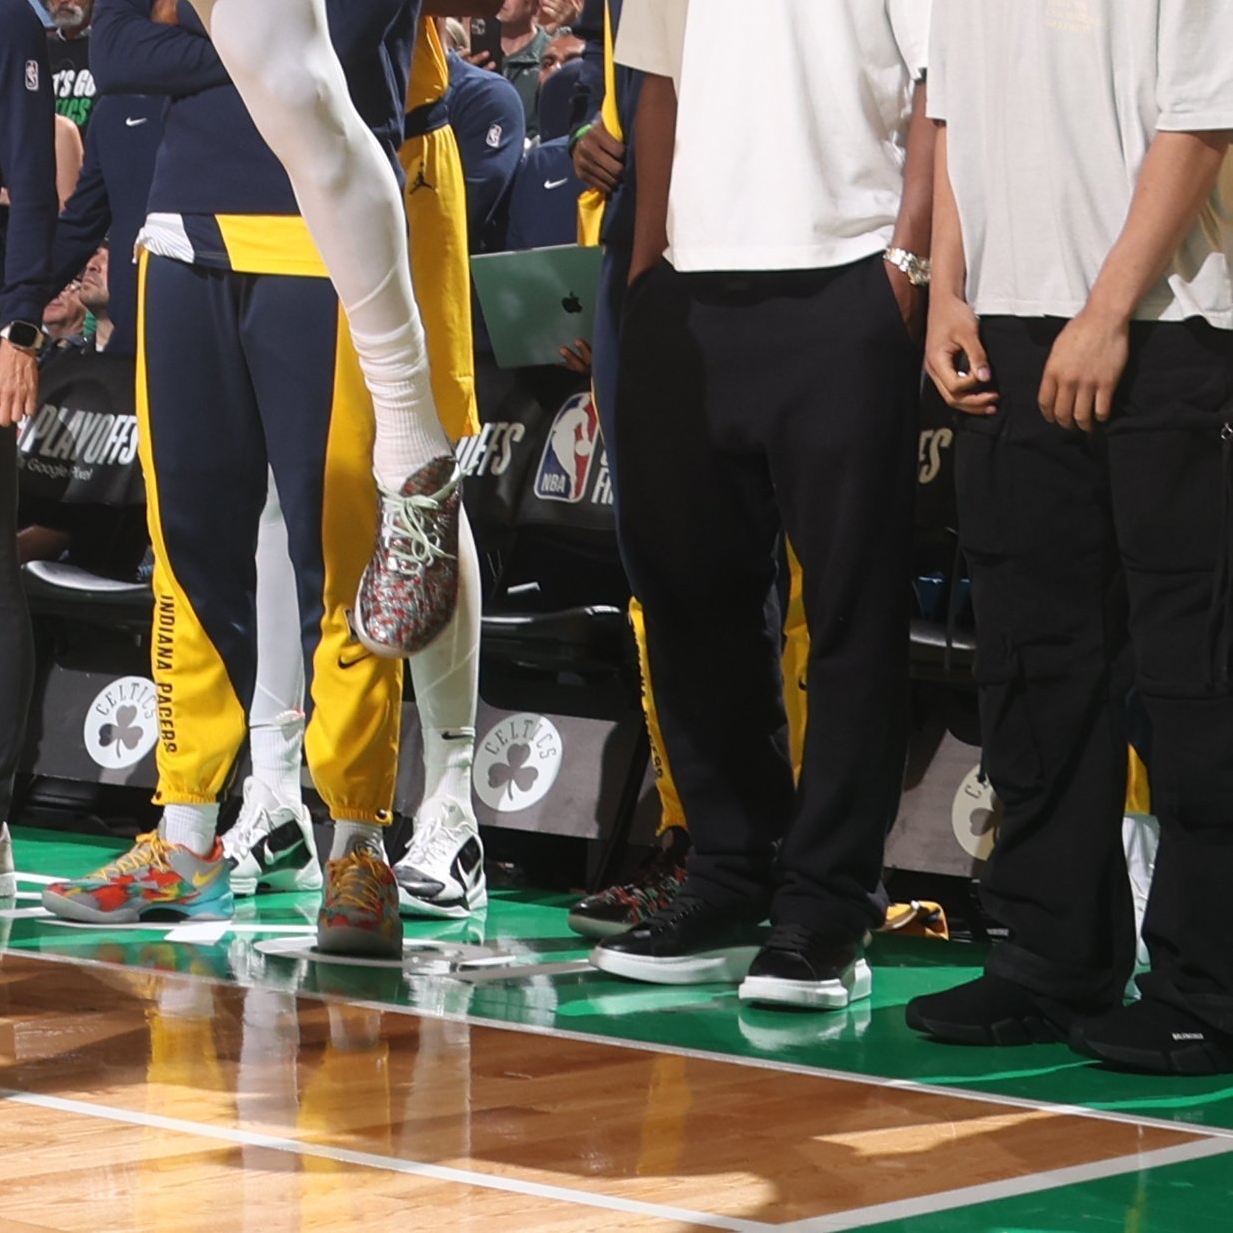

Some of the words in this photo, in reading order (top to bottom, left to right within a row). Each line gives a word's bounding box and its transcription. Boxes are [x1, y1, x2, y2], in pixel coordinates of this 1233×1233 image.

[21, 404, 138, 465] PLAYOFFS
[541, 472, 567, 494] NBA
[156, 595, 175, 671] INDIANA
[96, 682, 158, 720] CELTICS
[157, 682, 178, 754] PACERS
[485, 719, 557, 760] CELTICS
